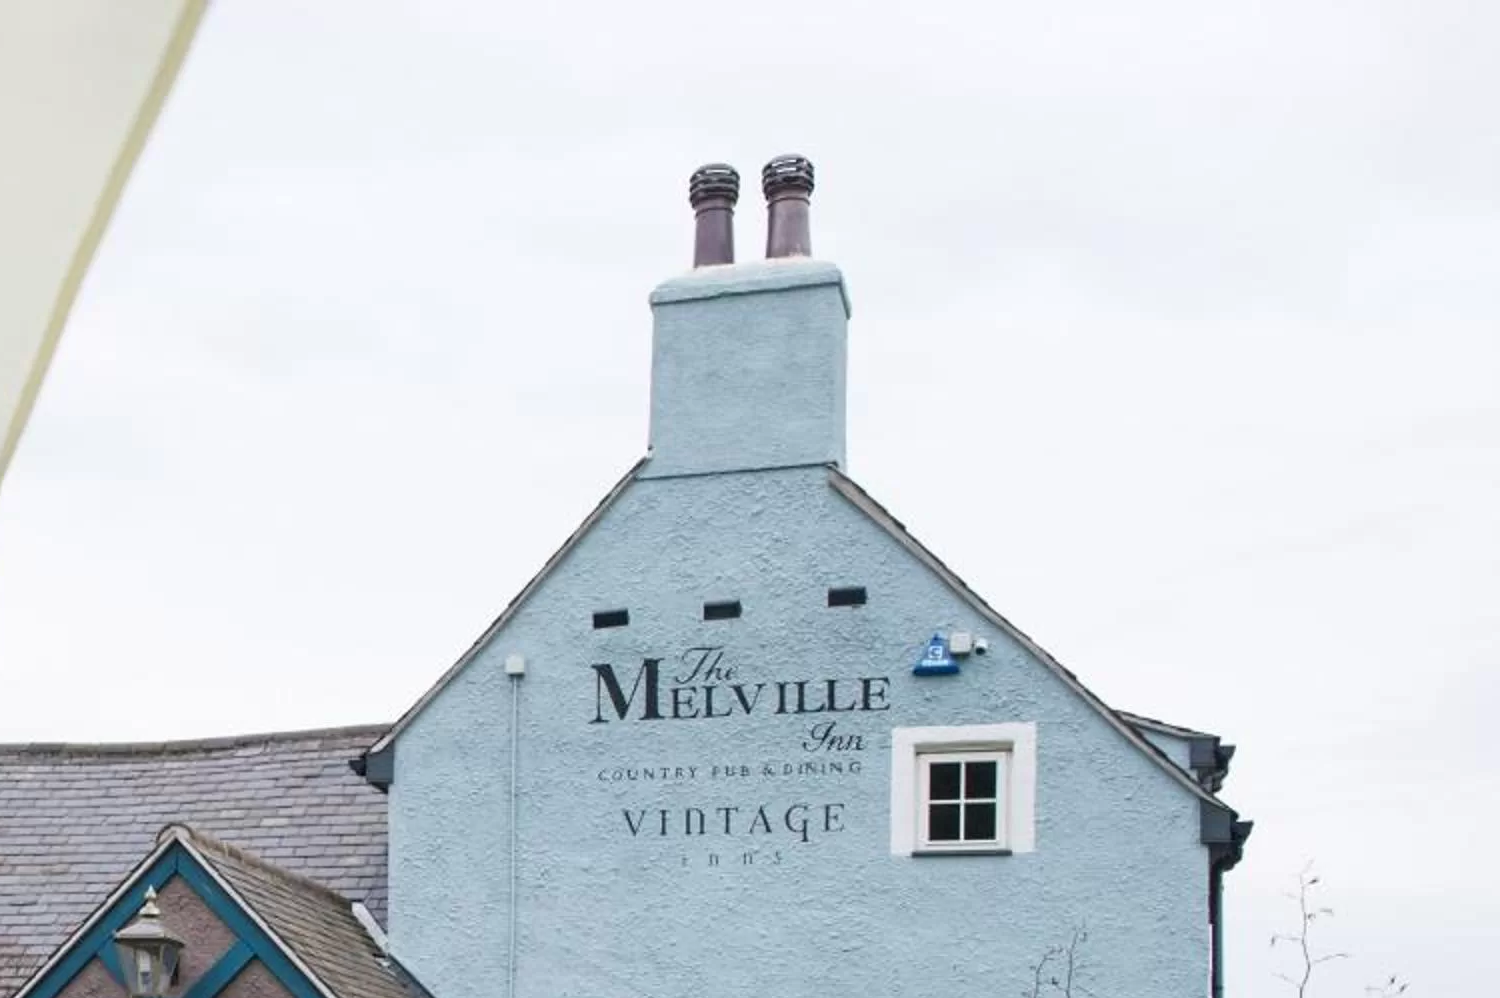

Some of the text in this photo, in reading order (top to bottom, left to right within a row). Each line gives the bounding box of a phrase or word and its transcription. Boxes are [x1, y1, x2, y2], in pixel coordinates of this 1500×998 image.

[675, 646, 733, 684] The
[588, 658, 891, 724] MELVILLE
[802, 720, 864, 752] Inn
[597, 760, 862, 782] COUNTRY PUB & DINING
[622, 803, 846, 842] VINTAGE
